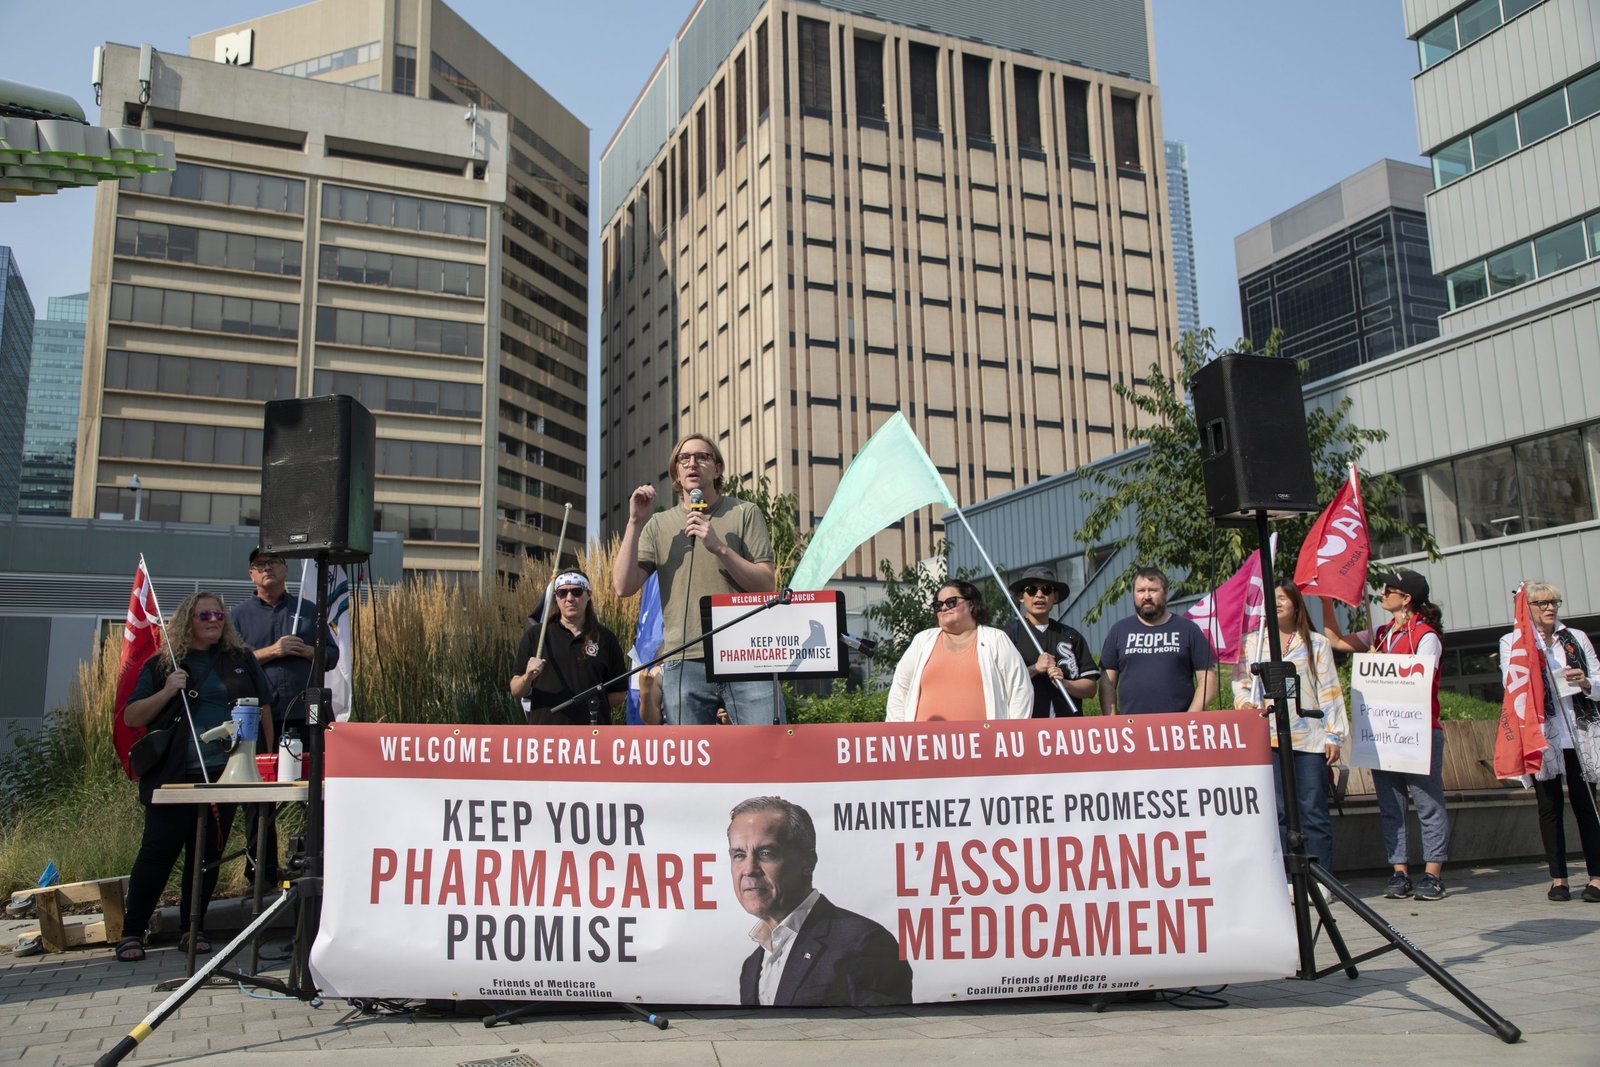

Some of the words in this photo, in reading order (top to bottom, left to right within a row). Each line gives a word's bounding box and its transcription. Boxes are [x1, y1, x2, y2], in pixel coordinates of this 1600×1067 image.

[732, 595, 761, 604] WELCOME
[750, 636, 773, 648] KEEP
[775, 635, 800, 647] YOUR
[1126, 631, 1180, 648] PEOPLE
[719, 648, 788, 662] PHARMACARE
[789, 647, 831, 659] PROMISE
[1124, 647, 1153, 655] BEFORE
[1153, 645, 1180, 654] PROFIT
[1359, 661, 1398, 678] UNA
[1360, 704, 1422, 719] Pharmacare
[836, 732, 982, 764] BIENVENUE
[994, 731, 1025, 758] AU
[1037, 726, 1136, 757] CAUCUS
[1147, 719, 1247, 753] LIBÉRAL
[1361, 729, 1391, 744] Health
[380, 735, 492, 763] WELCOME
[502, 738, 601, 765] LIBERAL
[612, 739, 711, 766] CAUCUS
[833, 798, 972, 832] MAINTENEZ
[980, 794, 1055, 826] VOTRE
[1064, 788, 1190, 823] PROMESSE
[1197, 785, 1260, 817] POUR
[442, 799, 533, 843] KEEP
[545, 801, 646, 847] YOUR
[370, 847, 717, 910] PHARMACARE
[898, 896, 1215, 961] MÉDICAMENT
[447, 913, 638, 964] PROMISE
[493, 979, 531, 988] Friends
[535, 980, 544, 988] of
[547, 980, 596, 989] Medicare
[1001, 975, 1040, 985] Friends
[1043, 975, 1054, 984] of
[1057, 973, 1107, 983] Medicare
[479, 987, 527, 996] Canadian
[530, 989, 563, 997] Health
[565, 989, 613, 998] Coalition
[966, 986, 1014, 996] Coalition
[1017, 983, 1078, 993] canadienne
[1083, 982, 1095, 990] de
[1097, 981, 1108, 989] la
[1110, 980, 1140, 989] santé
